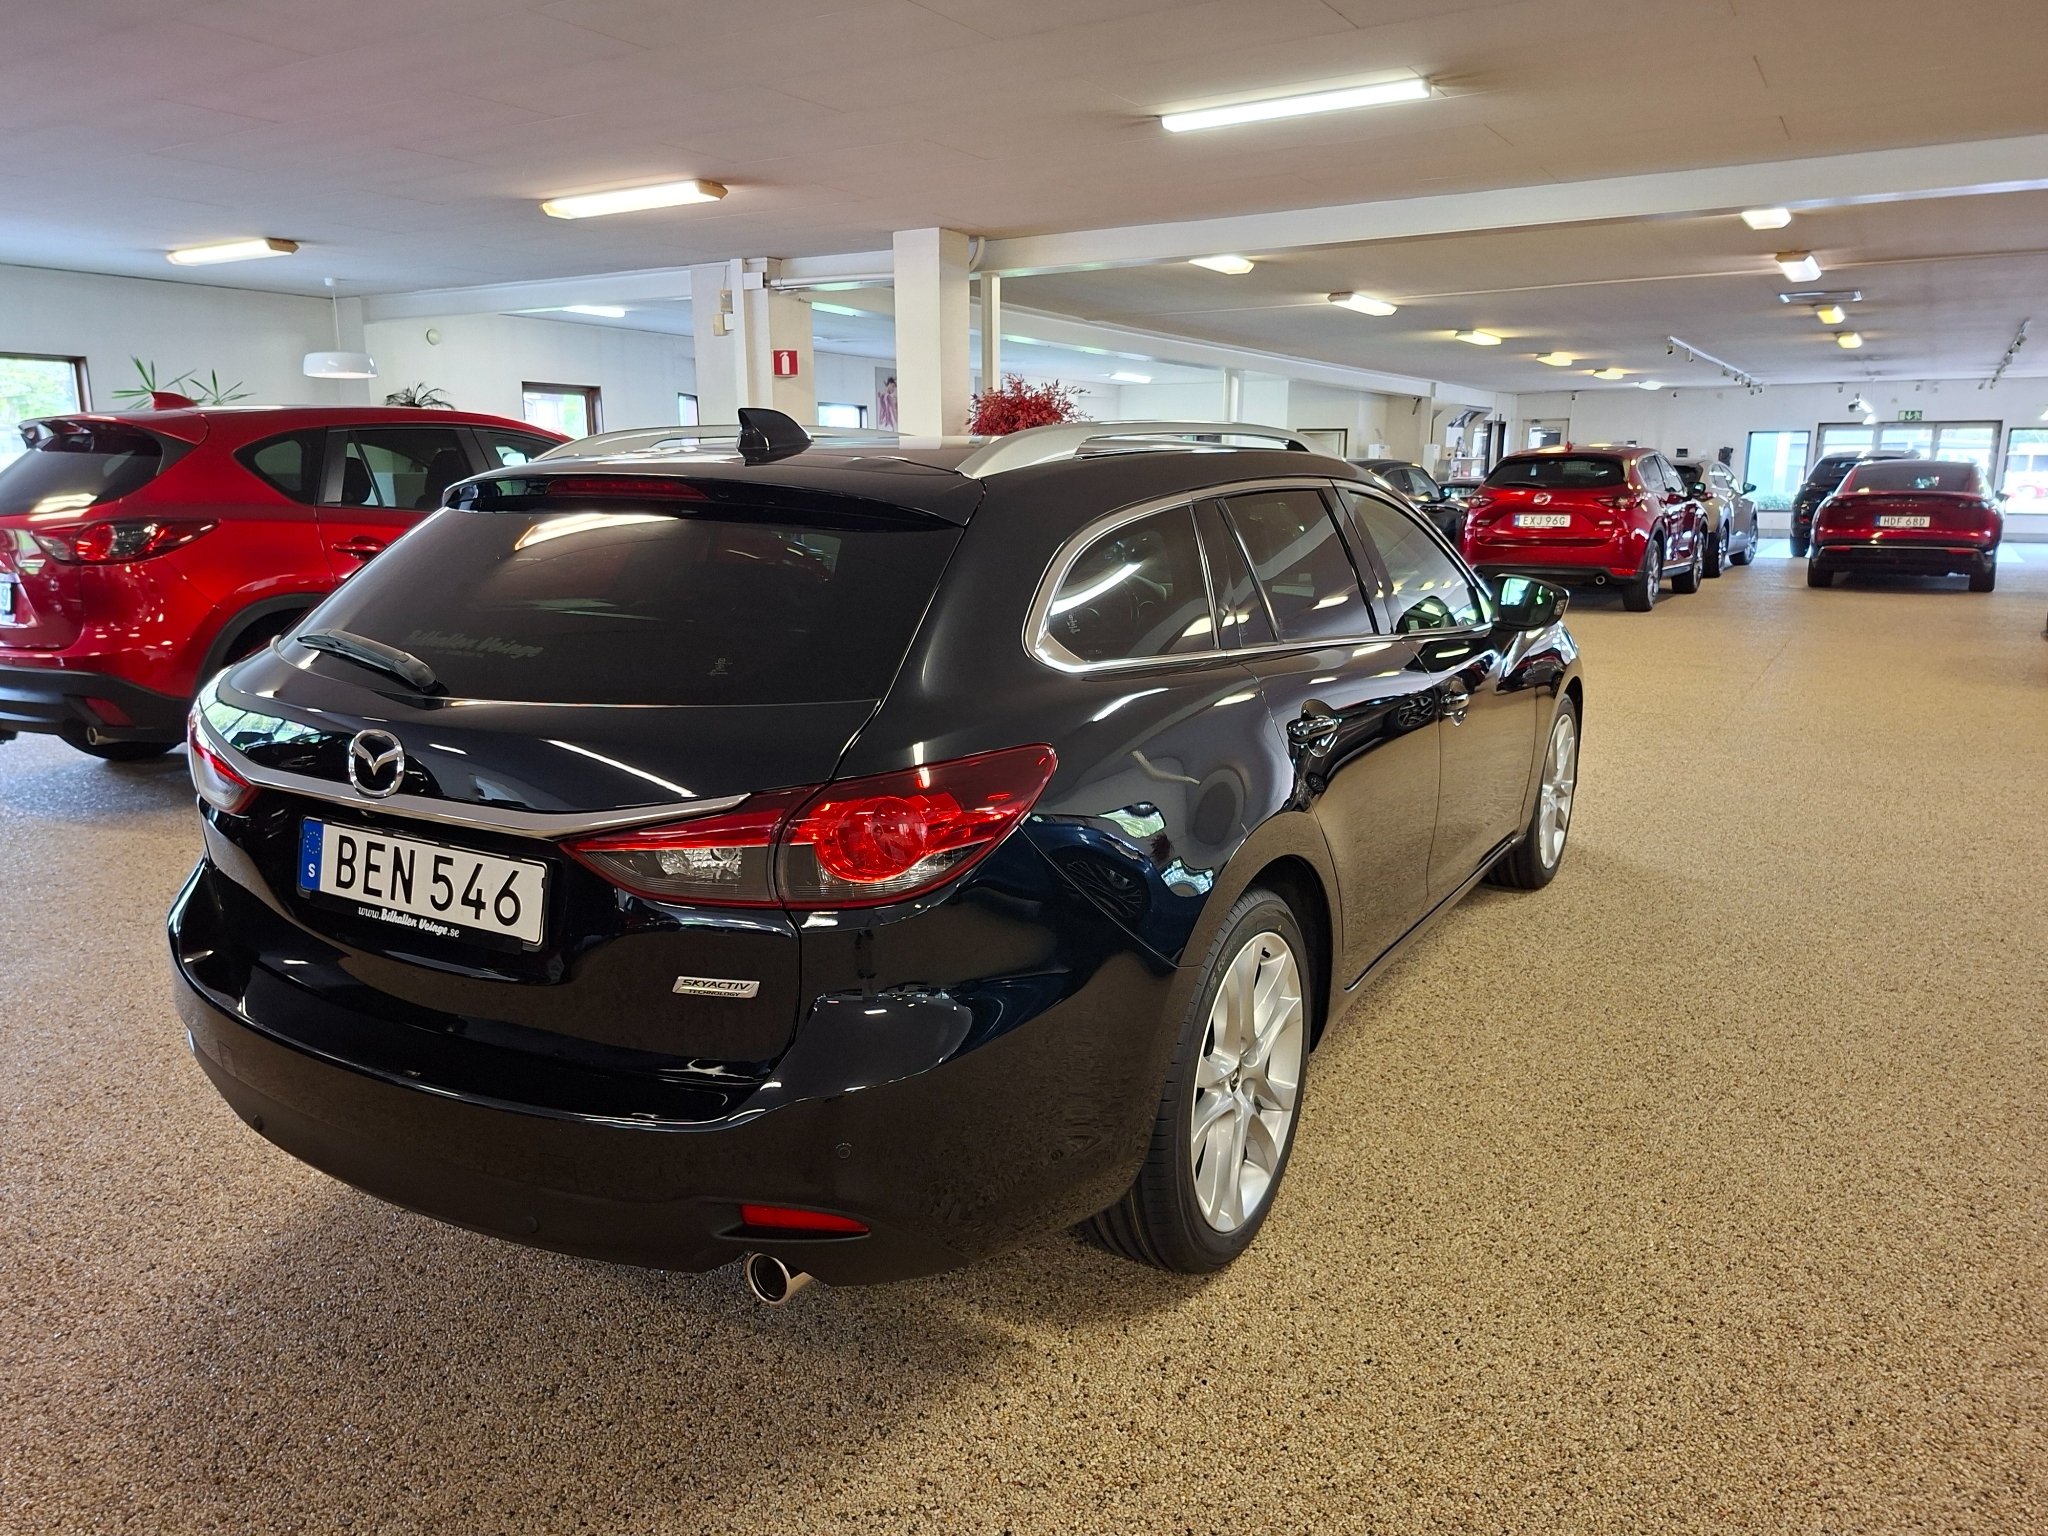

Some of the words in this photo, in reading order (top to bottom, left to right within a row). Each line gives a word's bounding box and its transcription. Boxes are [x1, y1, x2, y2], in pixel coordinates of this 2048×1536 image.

[1522, 516, 1543, 526] EXJ
[1545, 516, 1566, 526] 96G
[1883, 517, 1903, 526] HDF
[1905, 517, 1926, 526] 68D
[308, 863, 316, 878] S
[335, 834, 417, 906] BEN
[429, 854, 523, 927] 546
[358, 906, 417, 928] www.Bilhallen
[418, 918, 460, 938] Veinge.se
[681, 979, 751, 990] SKYACTIV
[689, 989, 742, 997] TECHNOLOGY
